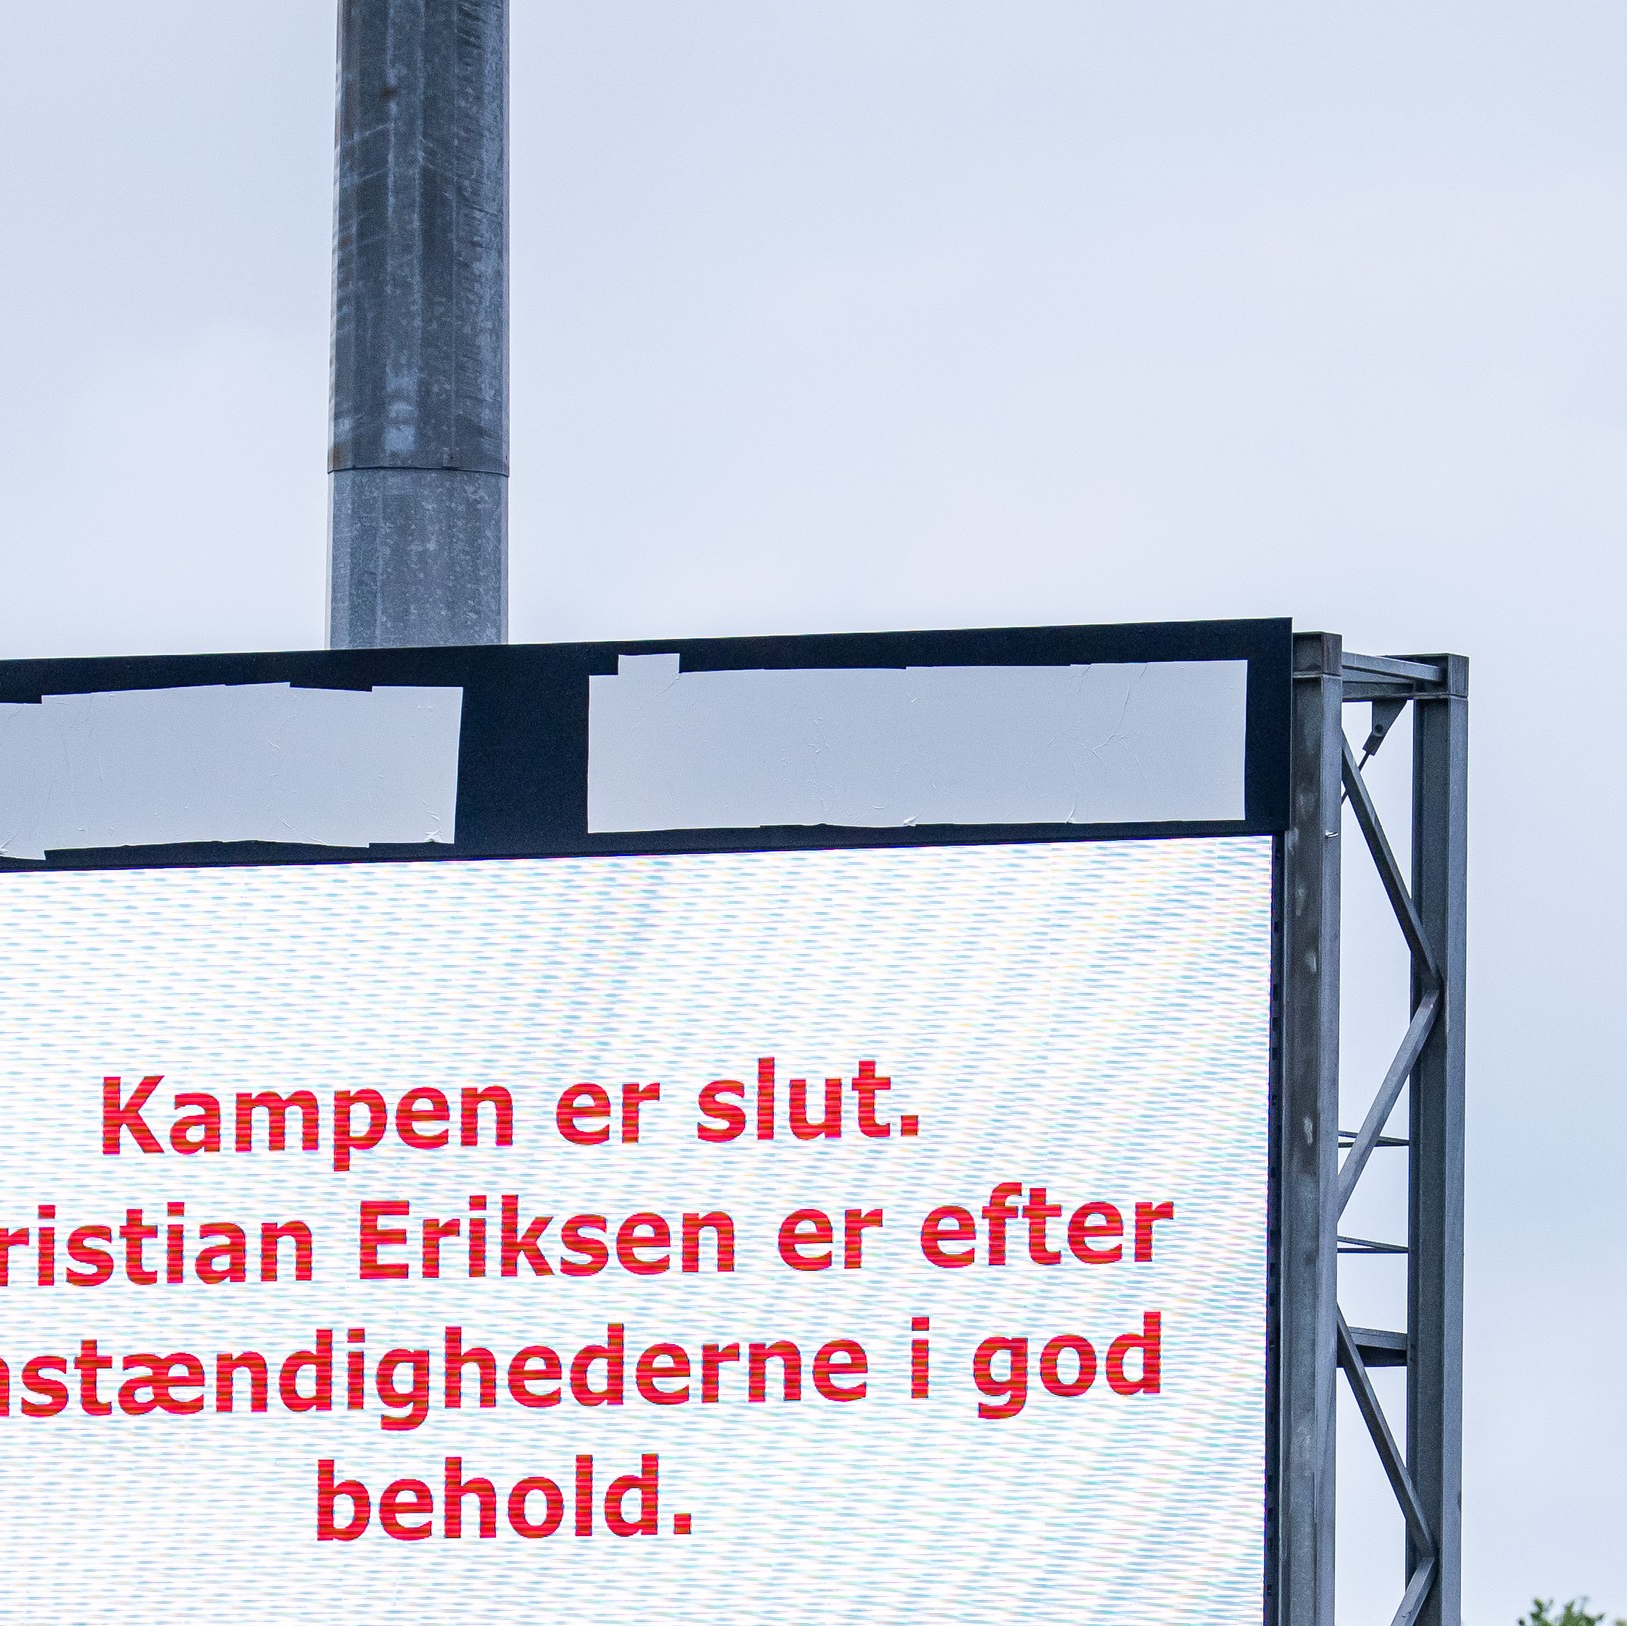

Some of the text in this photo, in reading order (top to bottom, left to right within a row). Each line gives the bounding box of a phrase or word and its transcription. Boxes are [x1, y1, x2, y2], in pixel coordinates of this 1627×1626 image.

[103, 1057, 920, 1172] Kampen er slut.
[359, 1194, 735, 1279] Eriksen
[778, 1209, 883, 1271] er
[920, 1181, 1175, 1268] efter
[911, 1316, 930, 1399] i
[973, 1311, 1162, 1420] god
[317, 1453, 693, 1542] behold.
